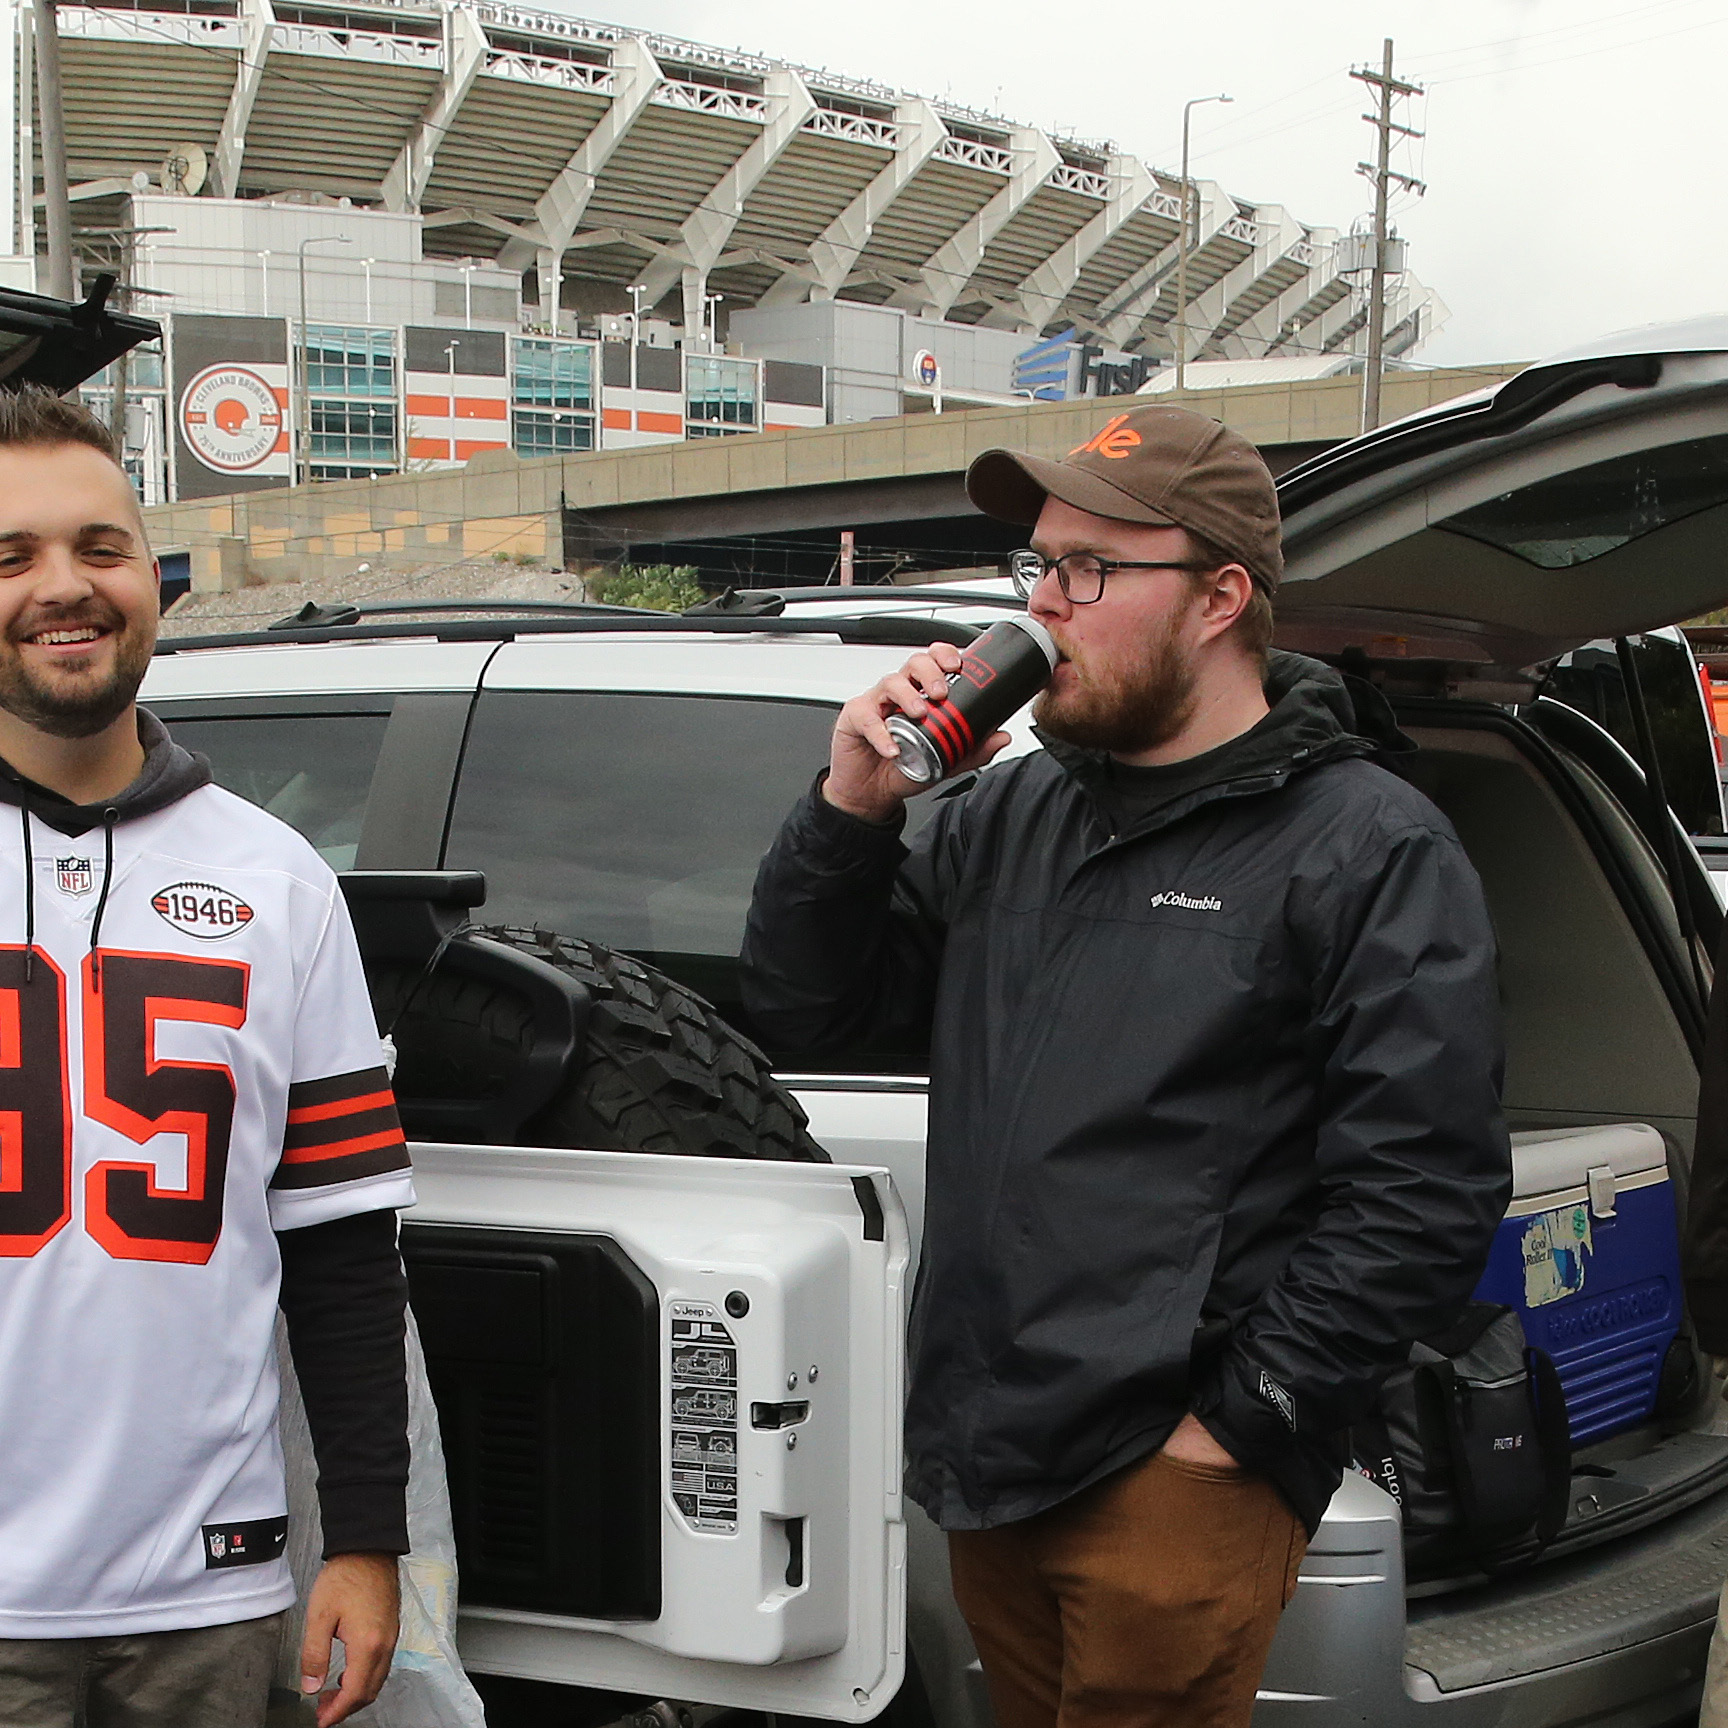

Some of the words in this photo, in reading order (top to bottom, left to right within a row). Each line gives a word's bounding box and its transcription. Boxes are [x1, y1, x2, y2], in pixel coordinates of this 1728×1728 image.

[195, 375, 237, 405] CLEVELAND
[237, 376, 270, 405] BROWNS
[215, 436, 270, 462] ANNIVERSARY
[60, 871, 89, 891] NFL
[169, 893, 236, 926] 1946
[1162, 891, 1222, 911] Columbia
[682, 1306, 705, 1318] Jeep
[673, 1322, 729, 1340] JL
[706, 1481, 736, 1492] USA
